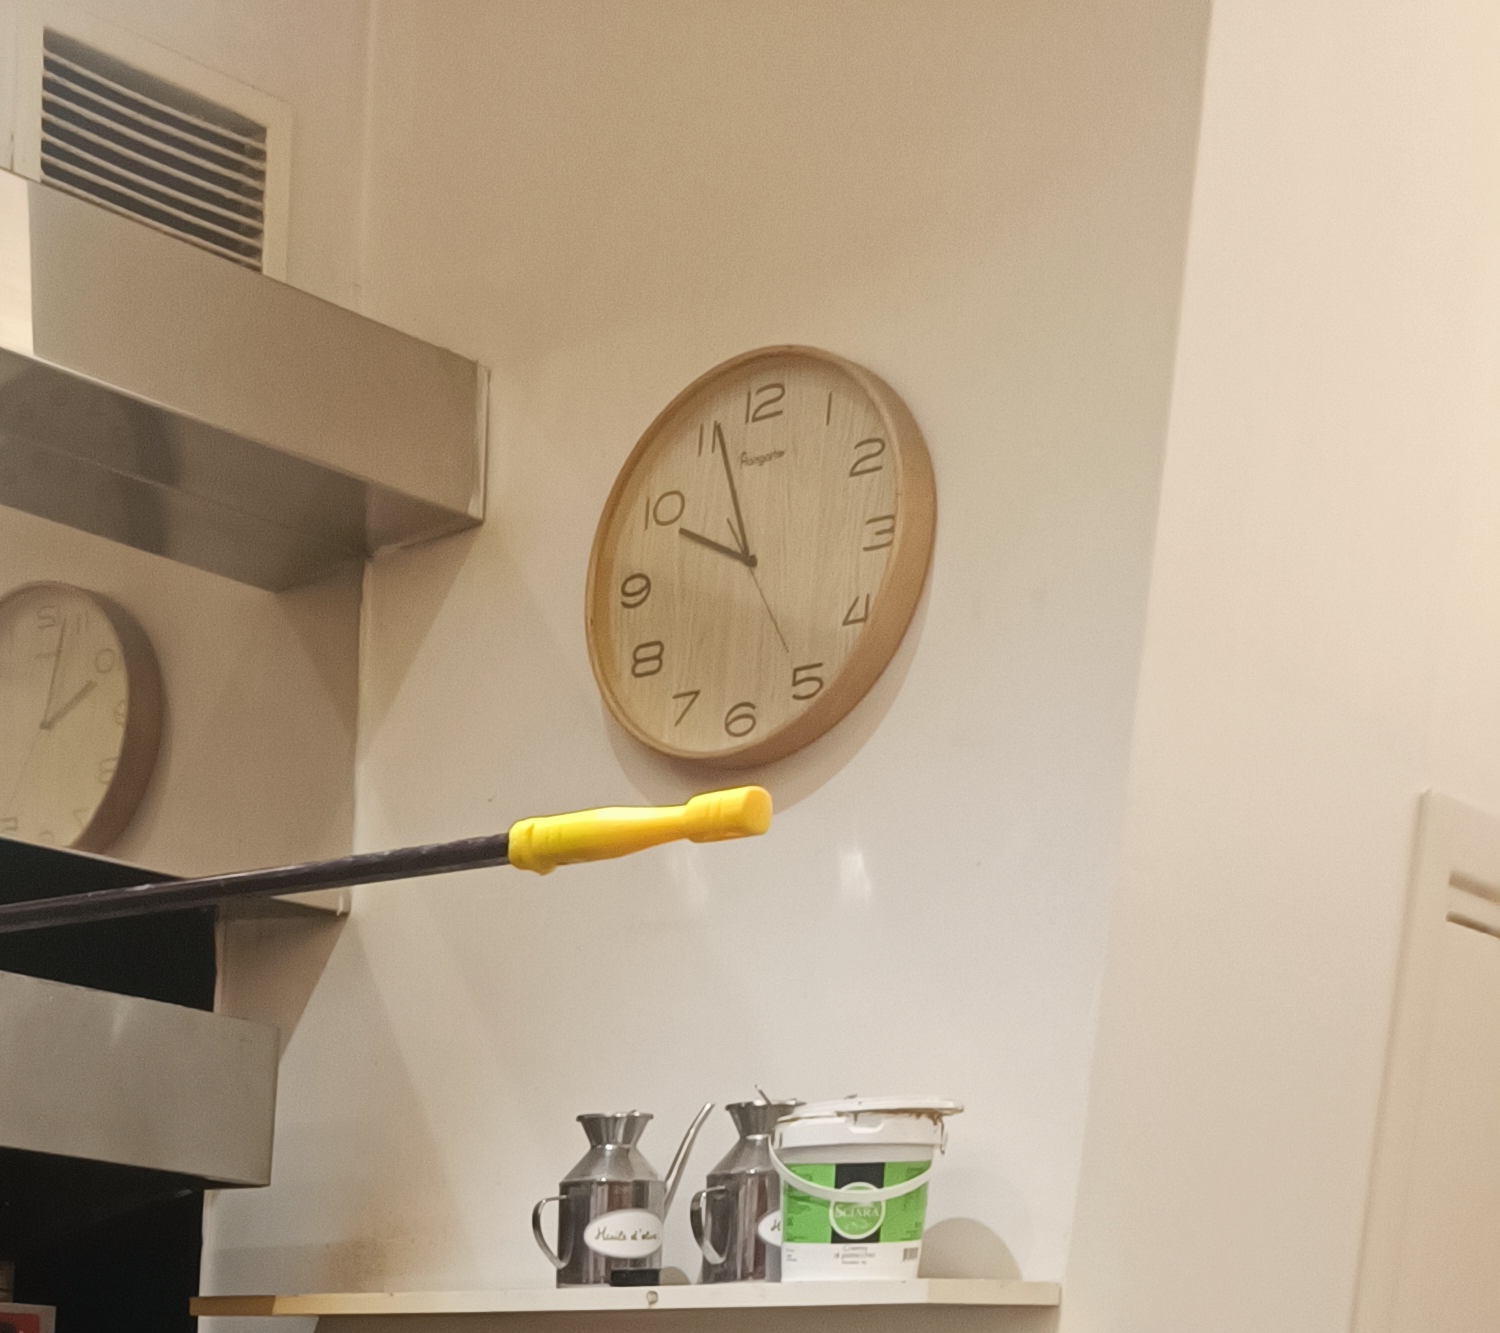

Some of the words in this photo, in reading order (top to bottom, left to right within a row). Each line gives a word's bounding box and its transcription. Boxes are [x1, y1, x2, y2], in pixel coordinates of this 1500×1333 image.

[745, 383, 786, 424] 12
[826, 391, 833, 425] 1
[698, 421, 718, 457] 11
[849, 438, 886, 477] 2
[644, 490, 686, 530] 10
[862, 515, 896, 551] 3
[620, 573, 651, 609] 9
[842, 594, 870, 626] 4
[631, 641, 665, 678] 8
[792, 663, 825, 700] 5
[673, 690, 700, 727] 7
[724, 702, 757, 737] 6
